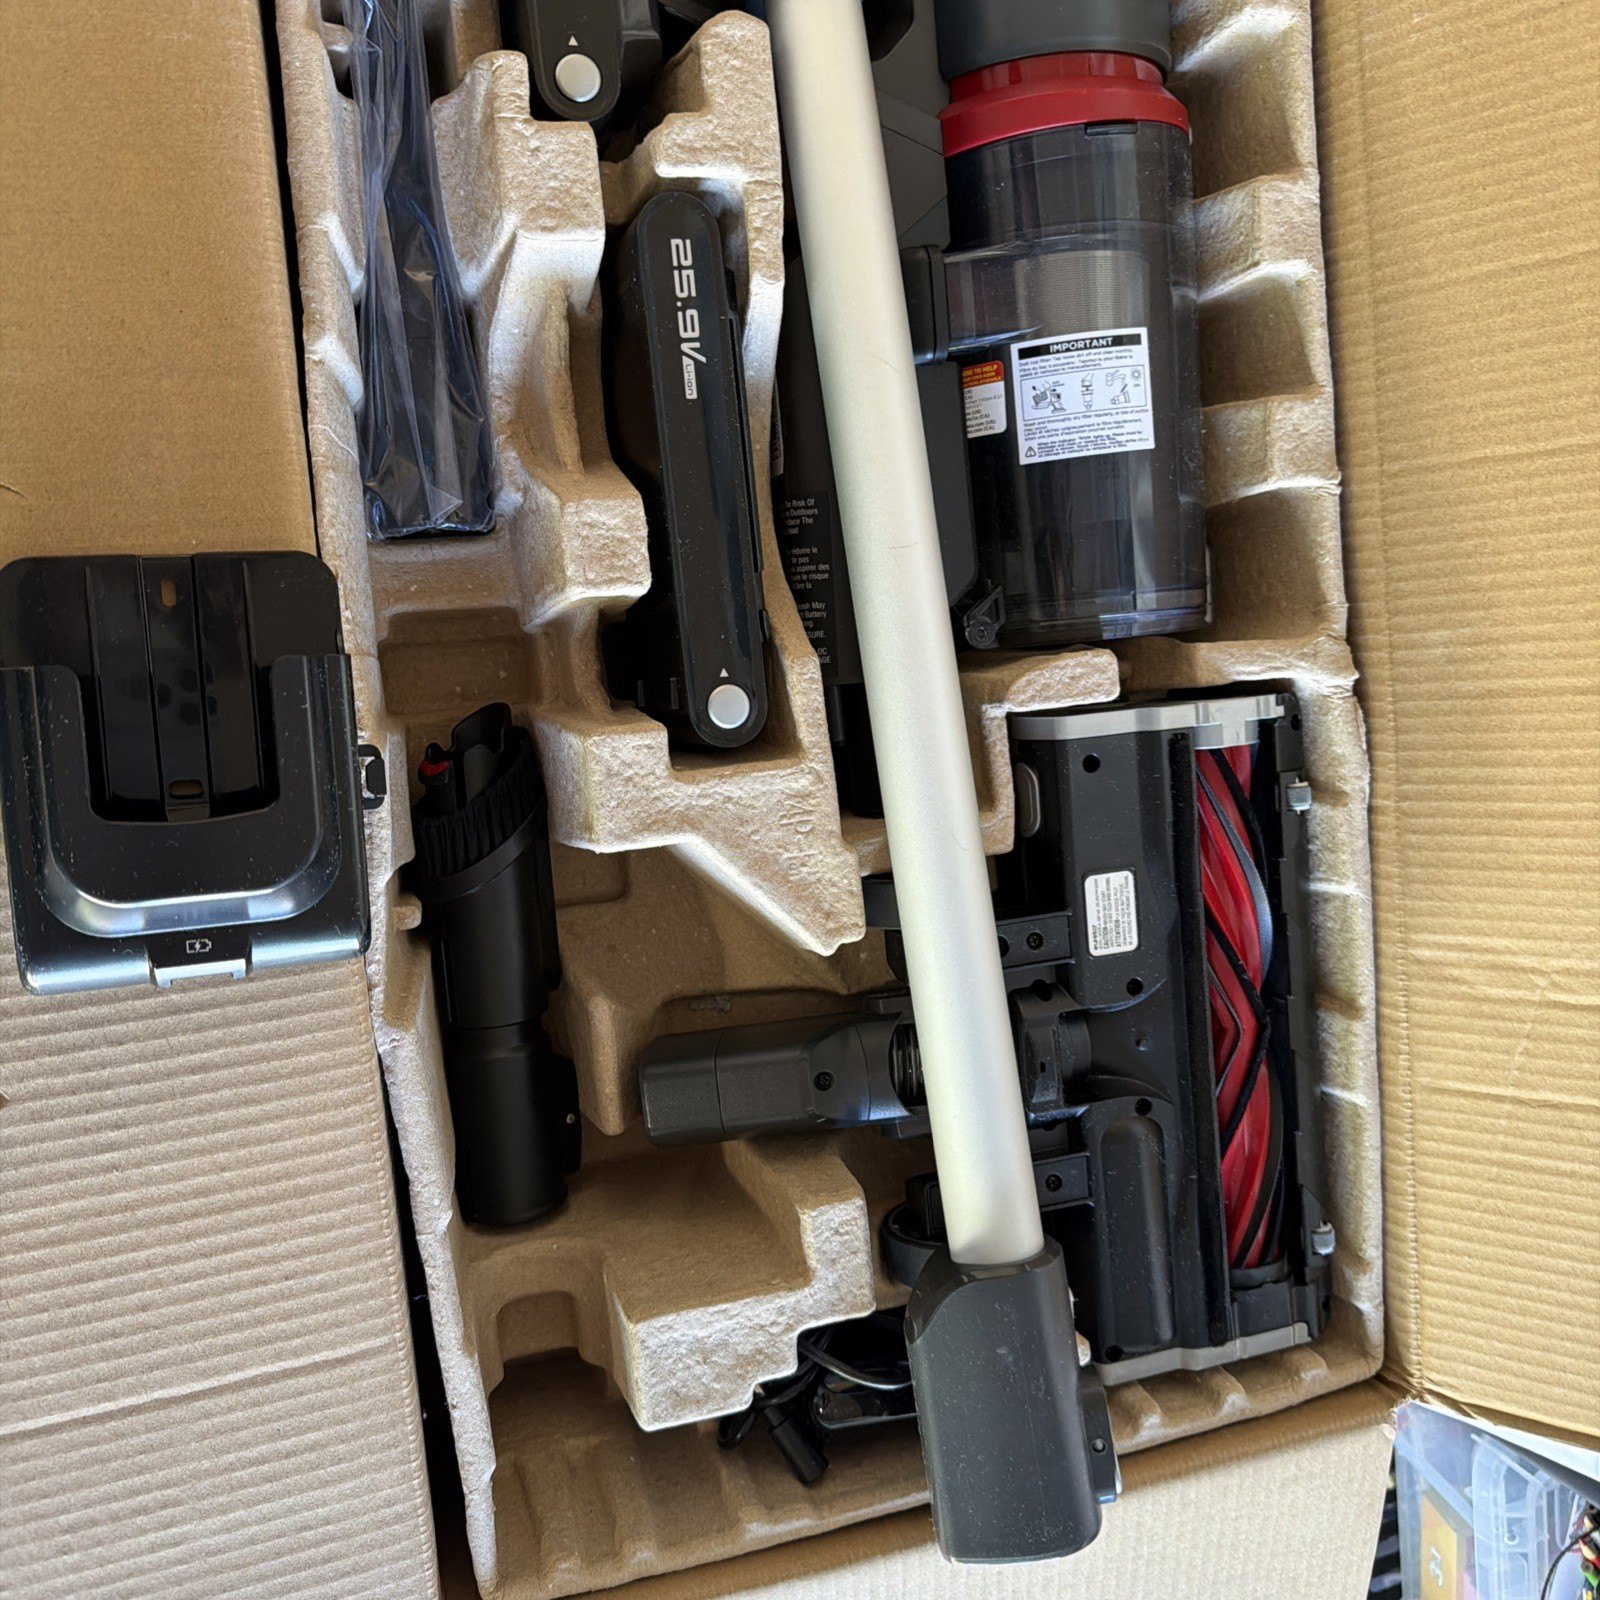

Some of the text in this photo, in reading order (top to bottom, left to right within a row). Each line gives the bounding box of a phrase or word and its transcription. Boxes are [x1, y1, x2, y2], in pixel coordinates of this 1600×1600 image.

[670, 238, 707, 363] 25.9V
[1050, 337, 1114, 353] IMPORTANT
[792, 499, 806, 507] Risk
[807, 498, 815, 506] Of
[790, 508, 819, 516] Outdoors
[802, 516, 814, 525] The
[818, 563, 830, 571] des
[808, 573, 829, 581] risque
[811, 601, 826, 610] May
